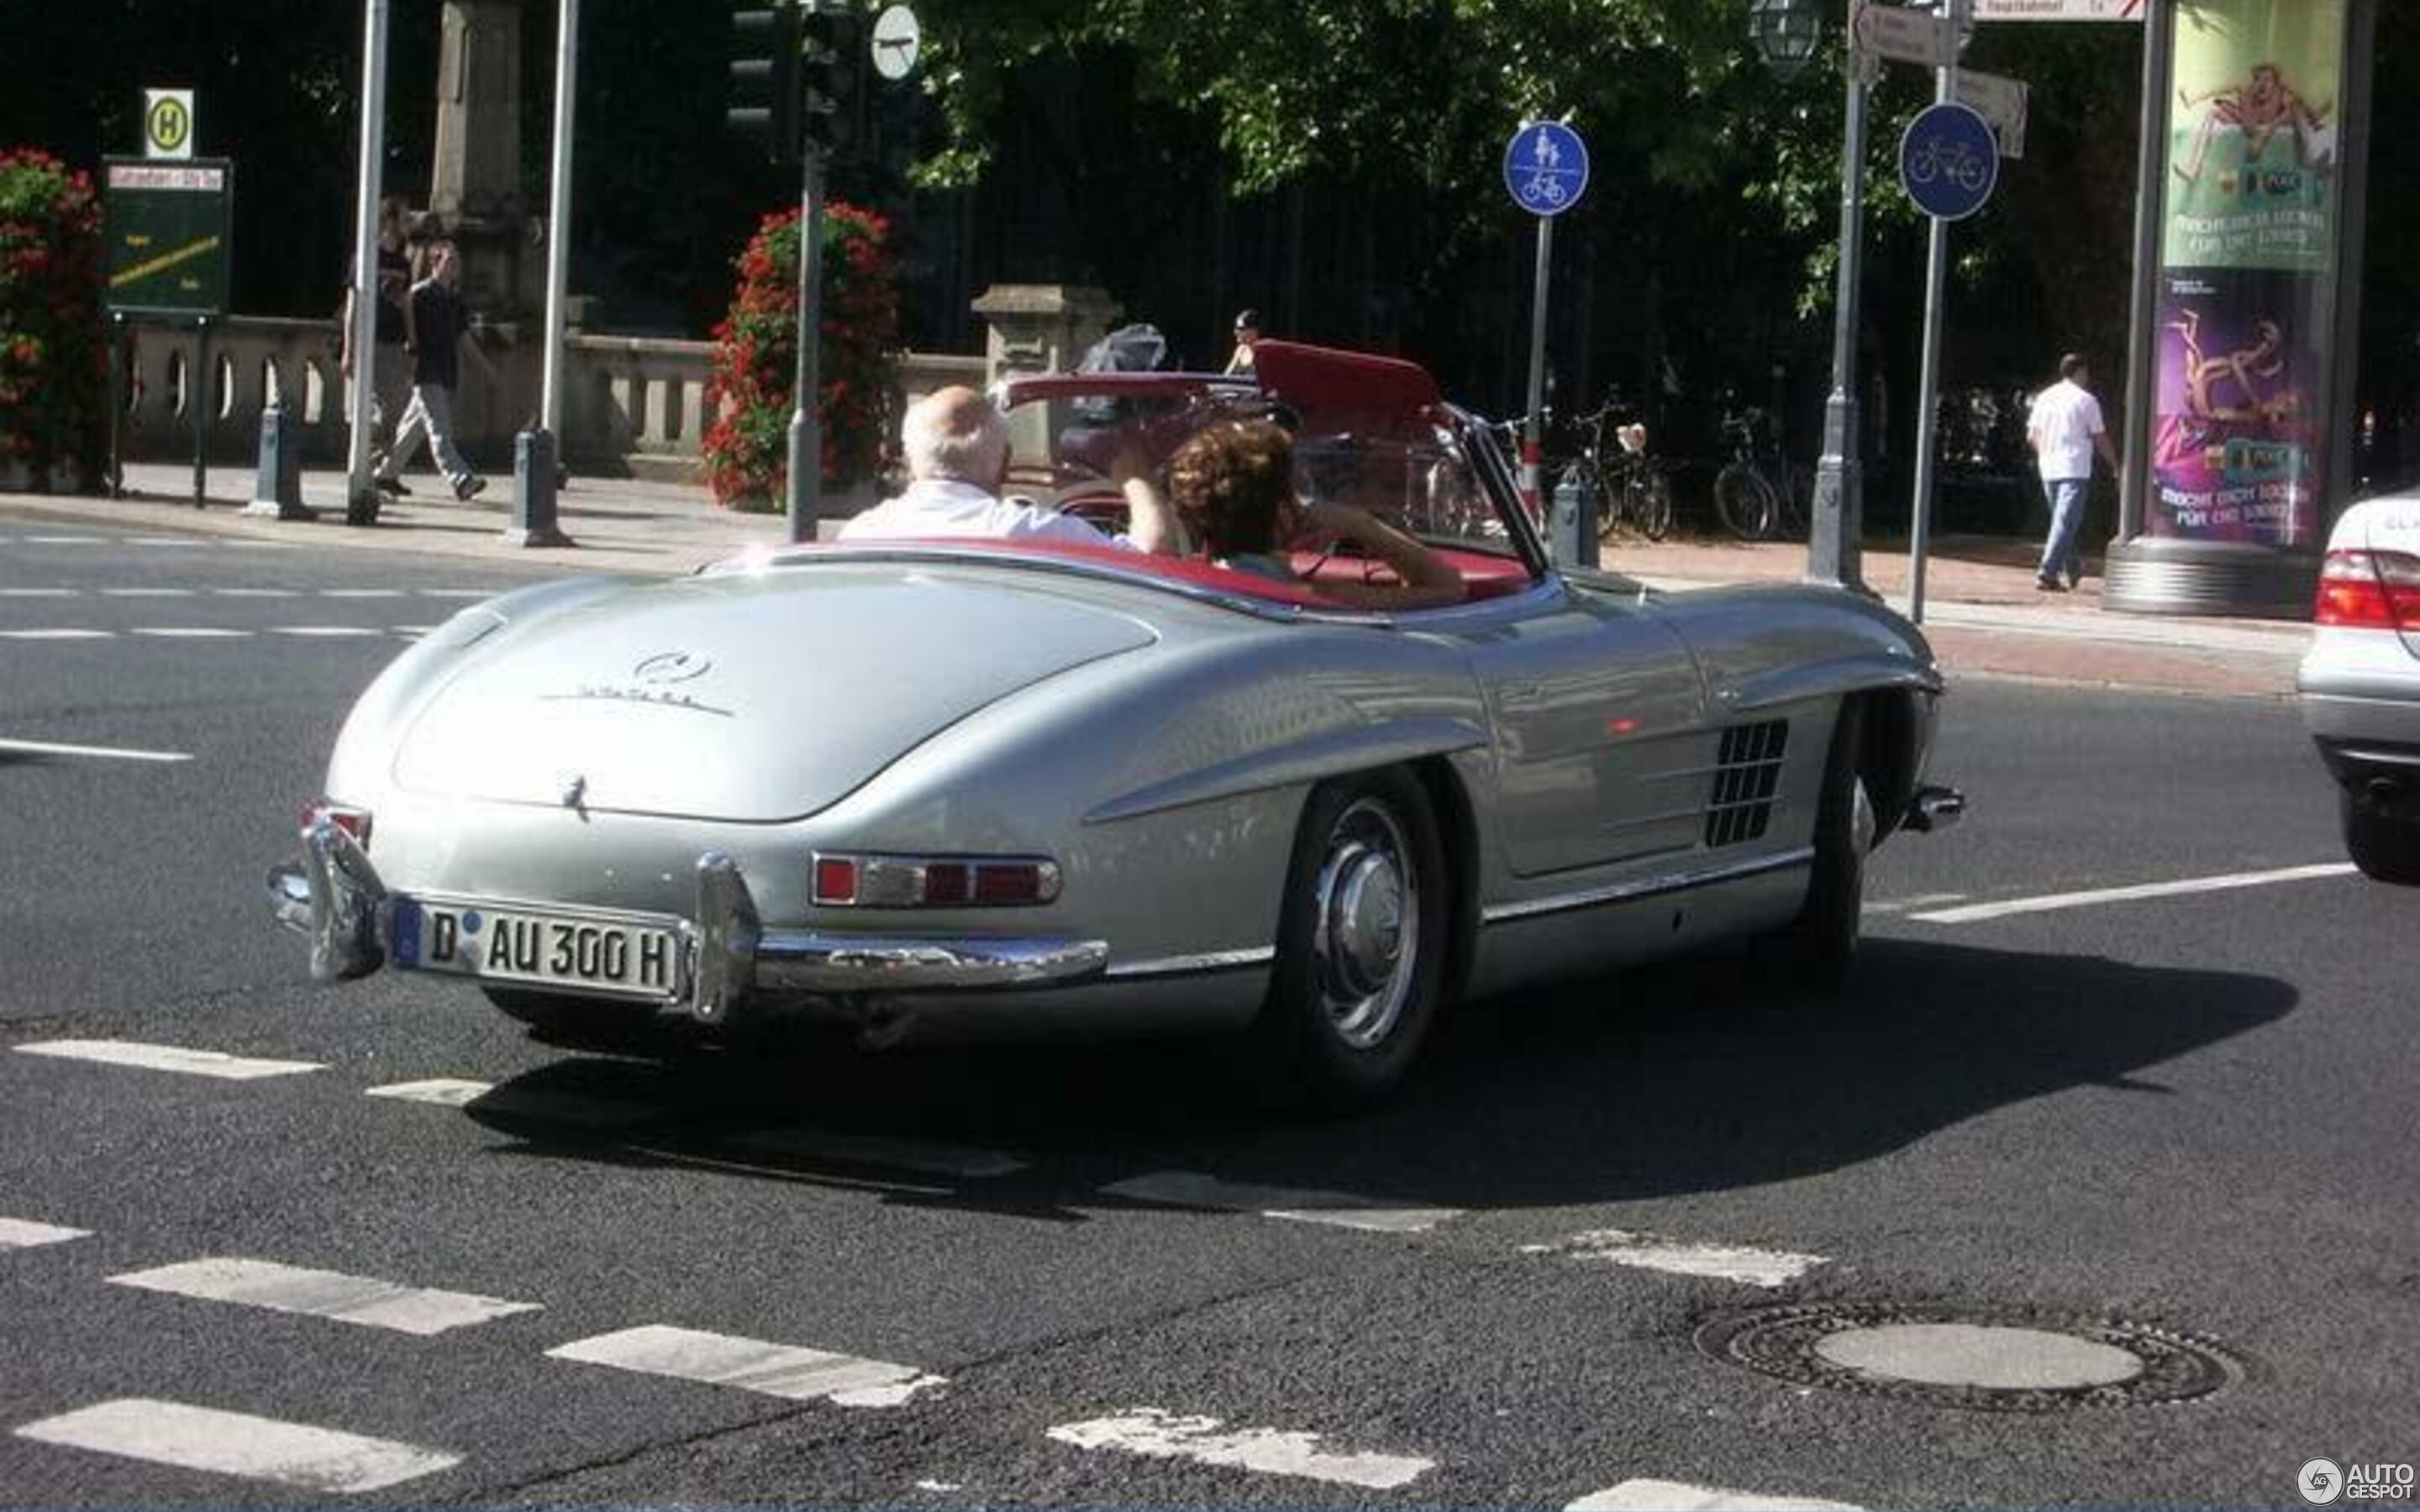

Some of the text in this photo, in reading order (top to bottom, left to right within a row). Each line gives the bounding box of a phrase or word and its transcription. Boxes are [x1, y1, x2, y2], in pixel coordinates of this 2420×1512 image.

[159, 109, 177, 139] H
[432, 912, 666, 985] D AU 300 H
